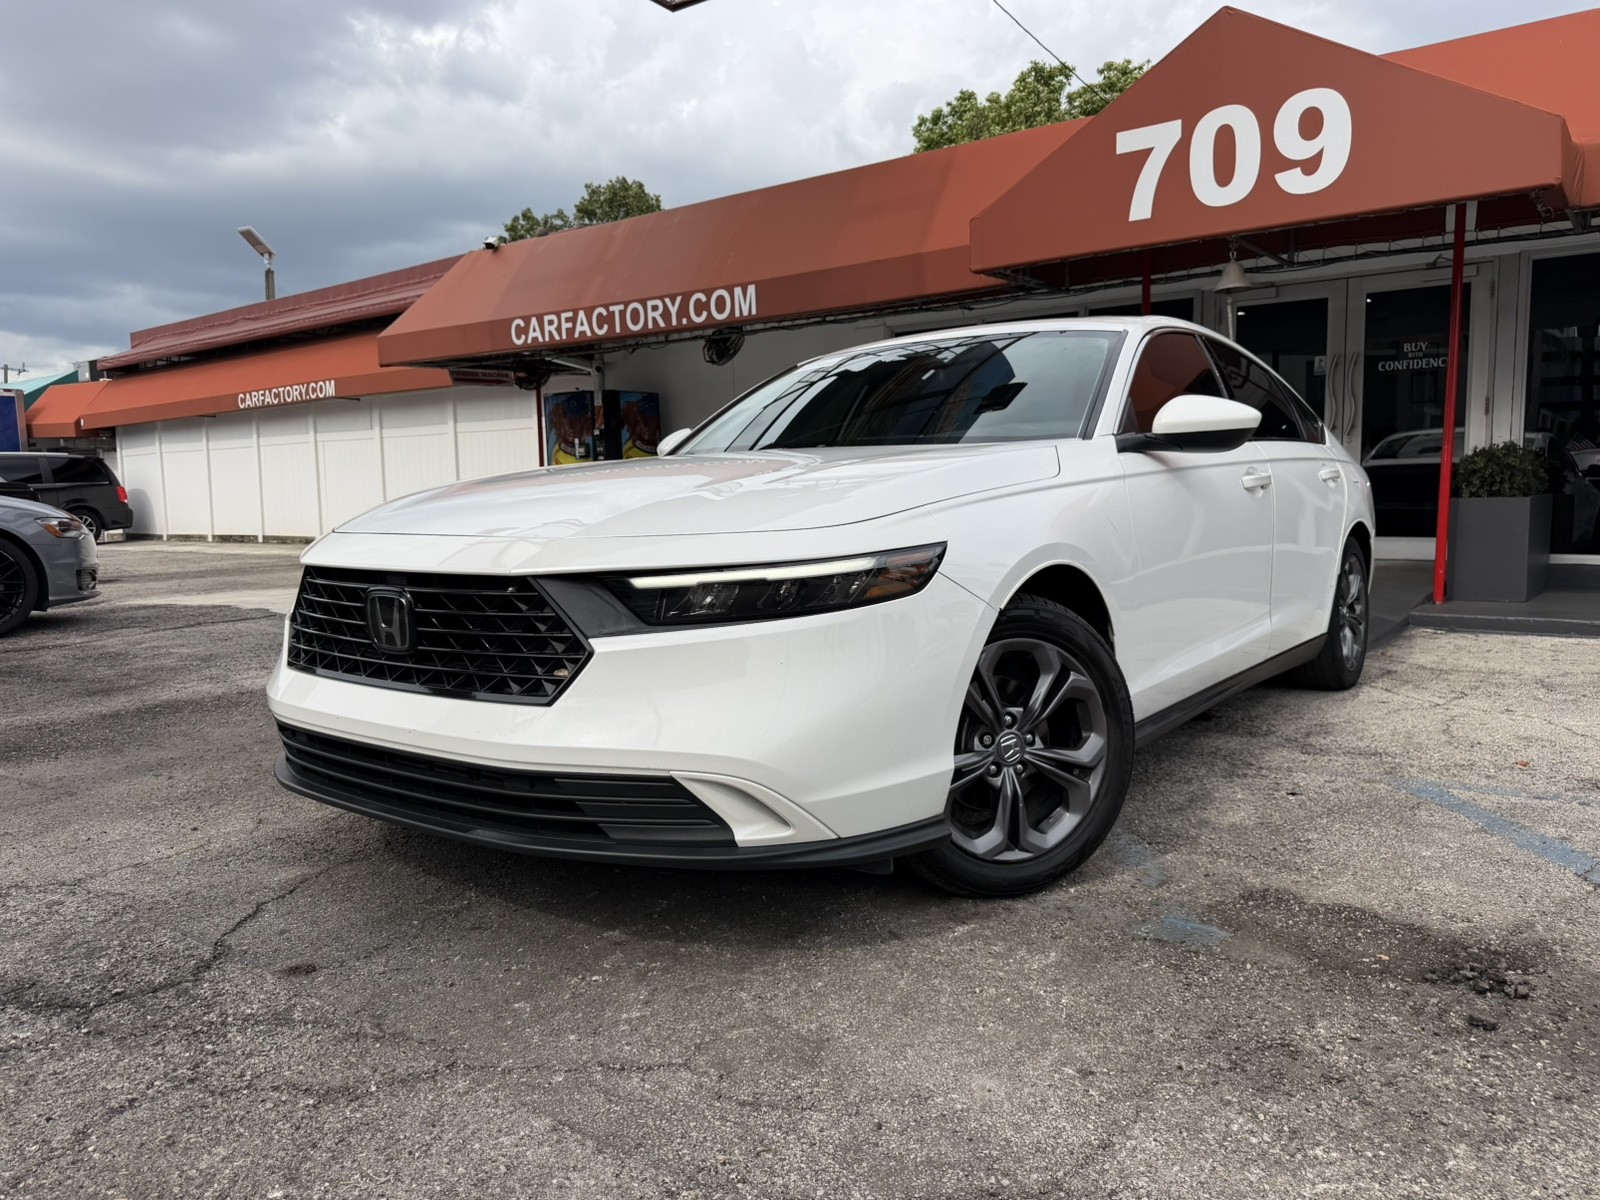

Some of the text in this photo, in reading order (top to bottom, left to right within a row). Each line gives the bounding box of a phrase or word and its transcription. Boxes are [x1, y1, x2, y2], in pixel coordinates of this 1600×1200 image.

[1116, 88, 1352, 222] 709
[510, 284, 757, 346] CARFACTORY.COM
[1403, 342, 1428, 353] BUY
[1378, 357, 1448, 372] CONFIDENC
[237, 380, 335, 409] CARFACTORY.COM
